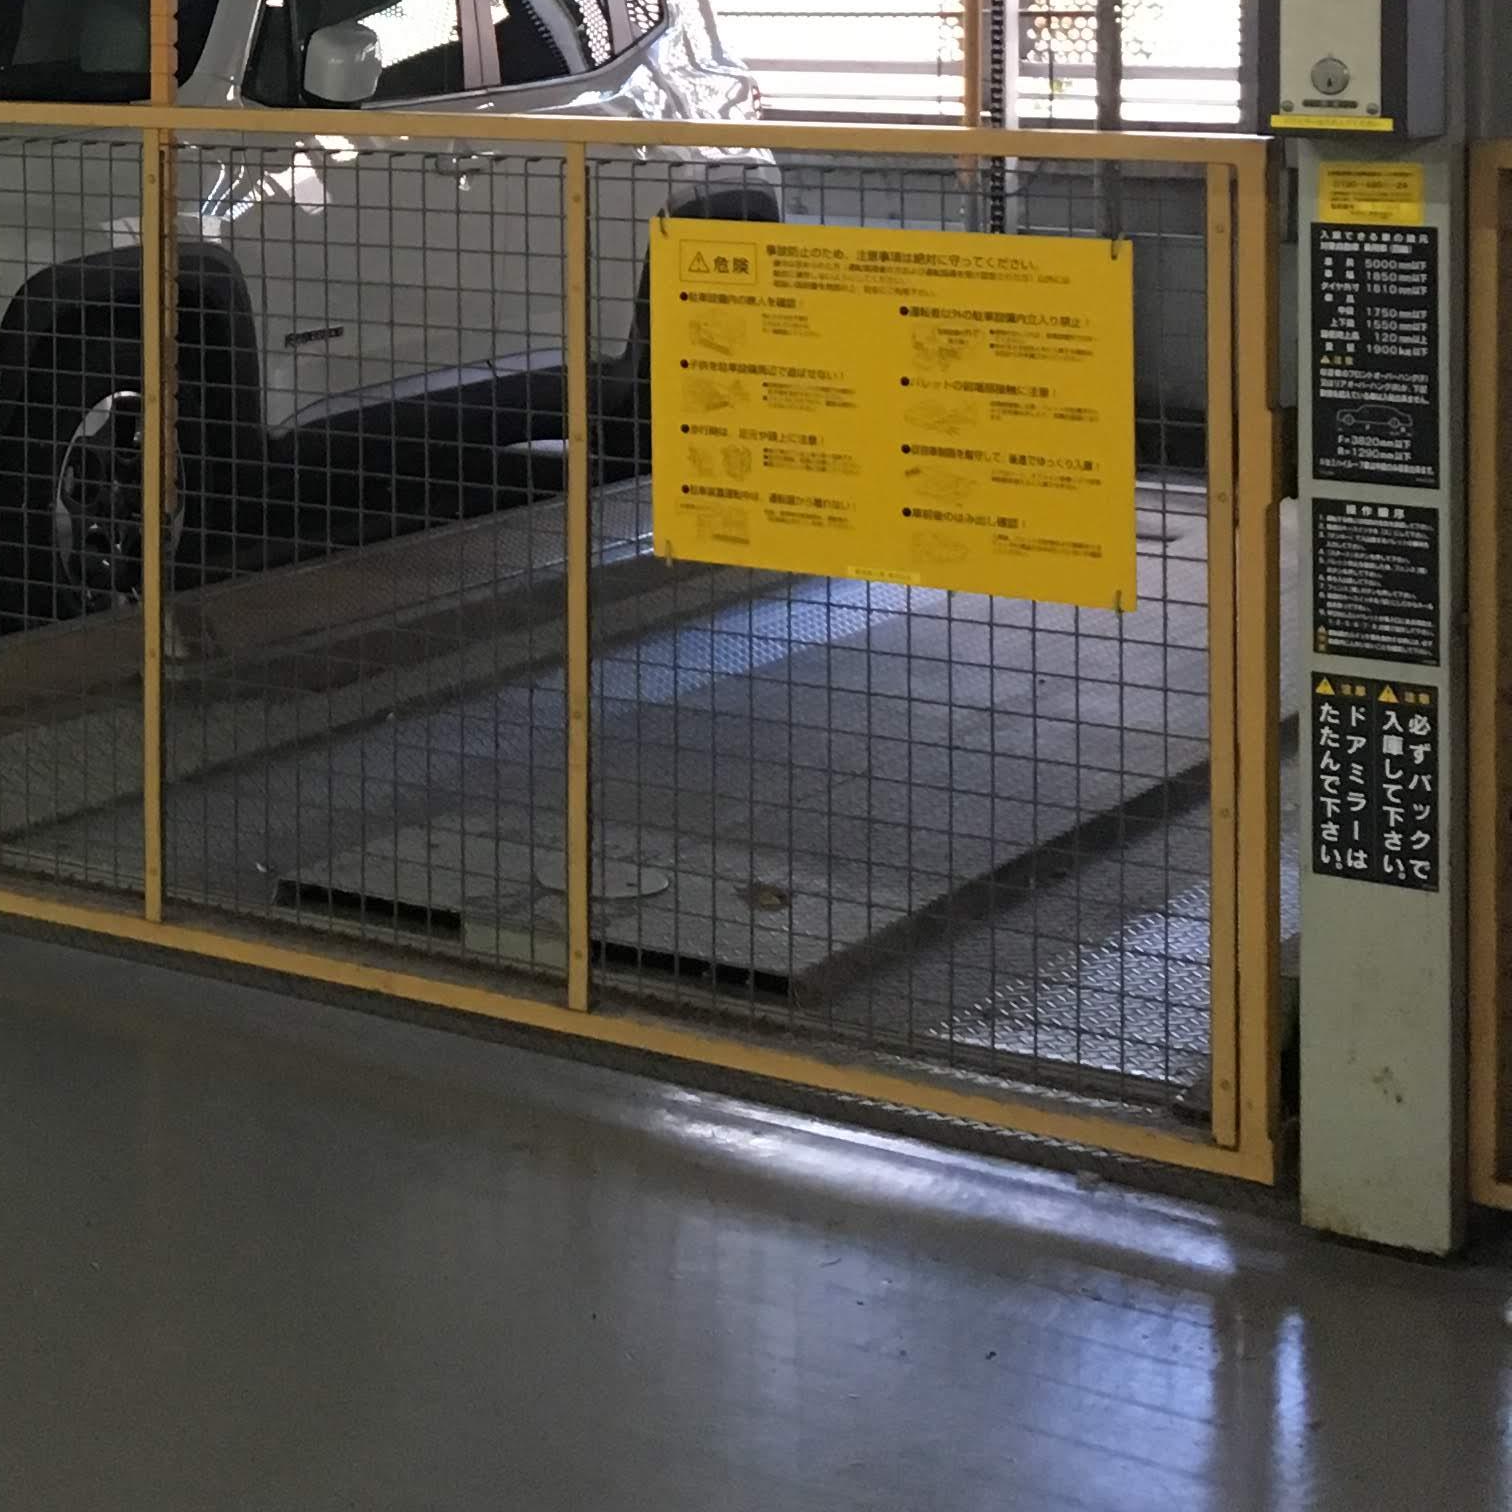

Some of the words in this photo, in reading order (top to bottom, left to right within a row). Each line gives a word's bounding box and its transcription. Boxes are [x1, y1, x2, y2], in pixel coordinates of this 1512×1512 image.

[713, 256, 751, 275] 危険
[1319, 702, 1344, 871] たたんで下さい。
[1346, 705, 1369, 871] ドアミラーは
[1382, 710, 1406, 881] 入庫して下さい。
[1408, 713, 1432, 881] 必ずバックで
